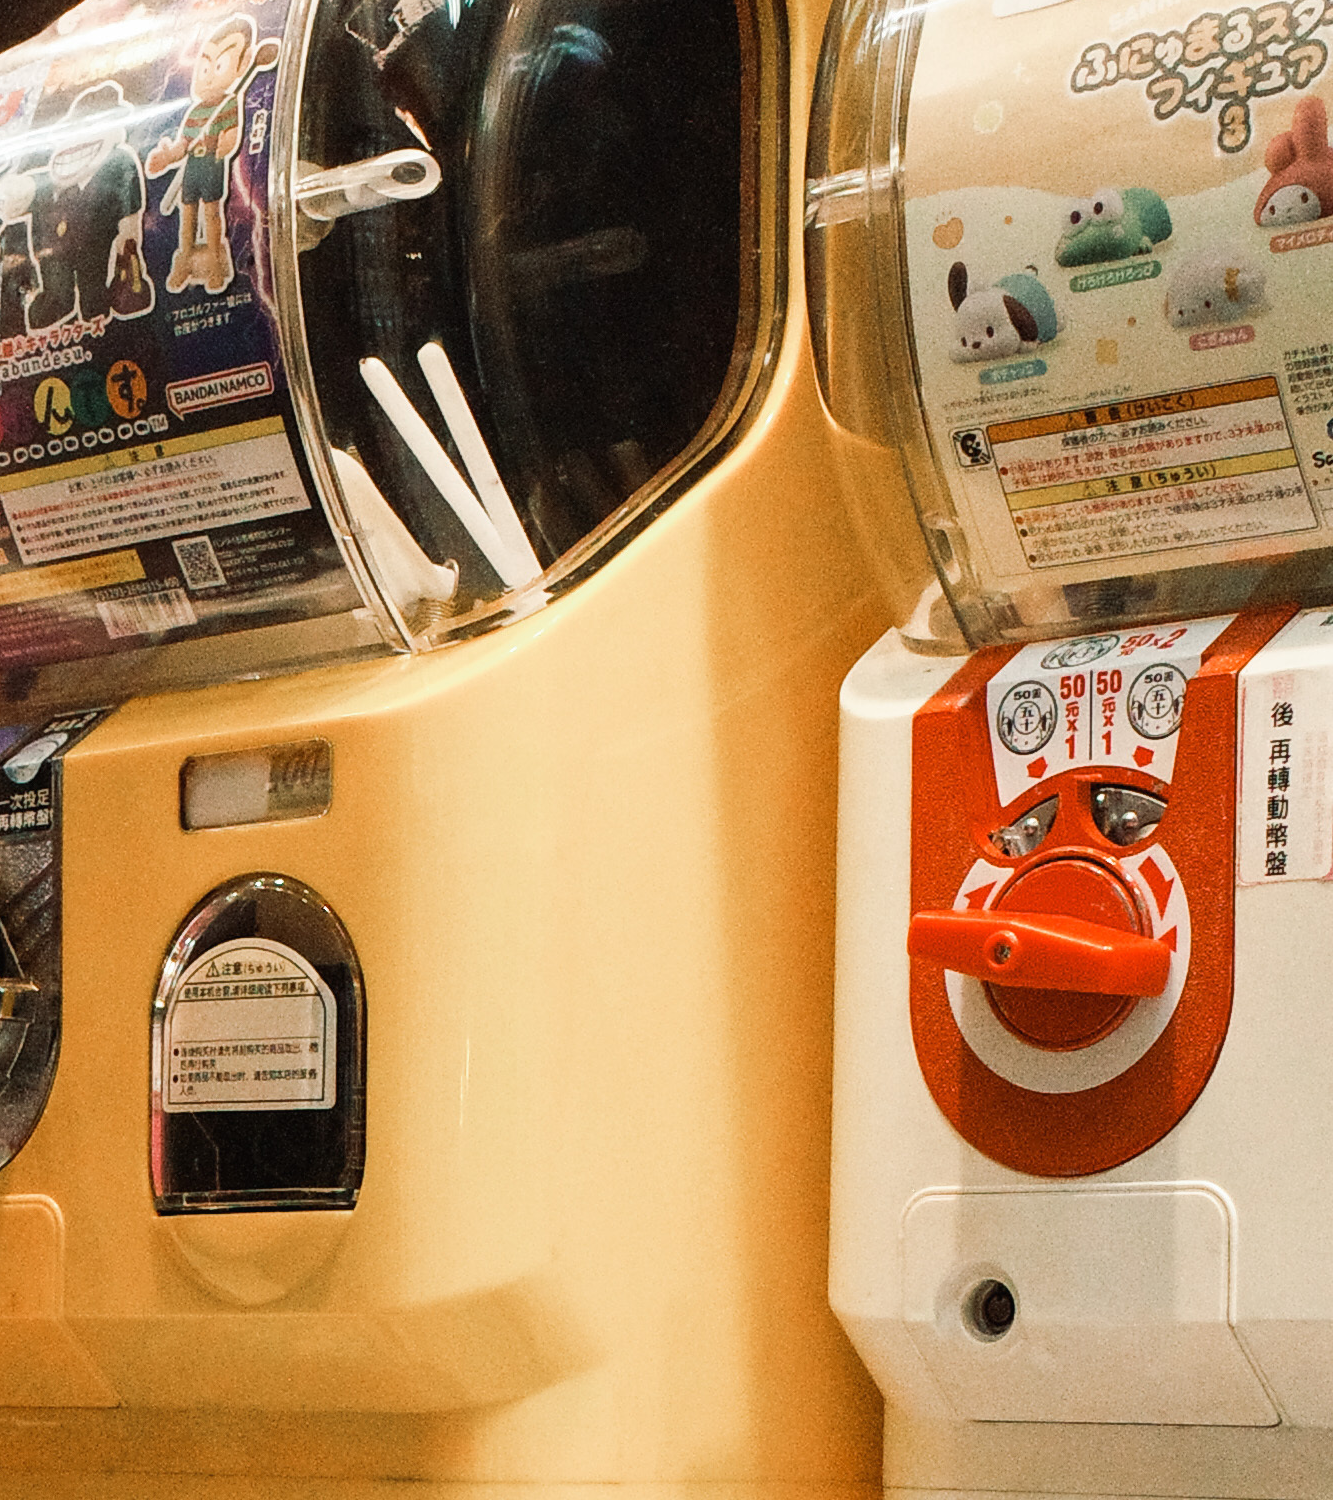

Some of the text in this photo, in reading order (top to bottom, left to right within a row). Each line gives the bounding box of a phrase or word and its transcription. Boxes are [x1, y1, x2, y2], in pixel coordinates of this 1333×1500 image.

[1146, 38, 1327, 119] フィギュア
[1218, 101, 1251, 152] 3
[1276, 227, 1333, 250] マイメロデ
[173, 373, 267, 406] BANDAI NAMCO
[222, 960, 286, 977] 注意(ちゅうい)
